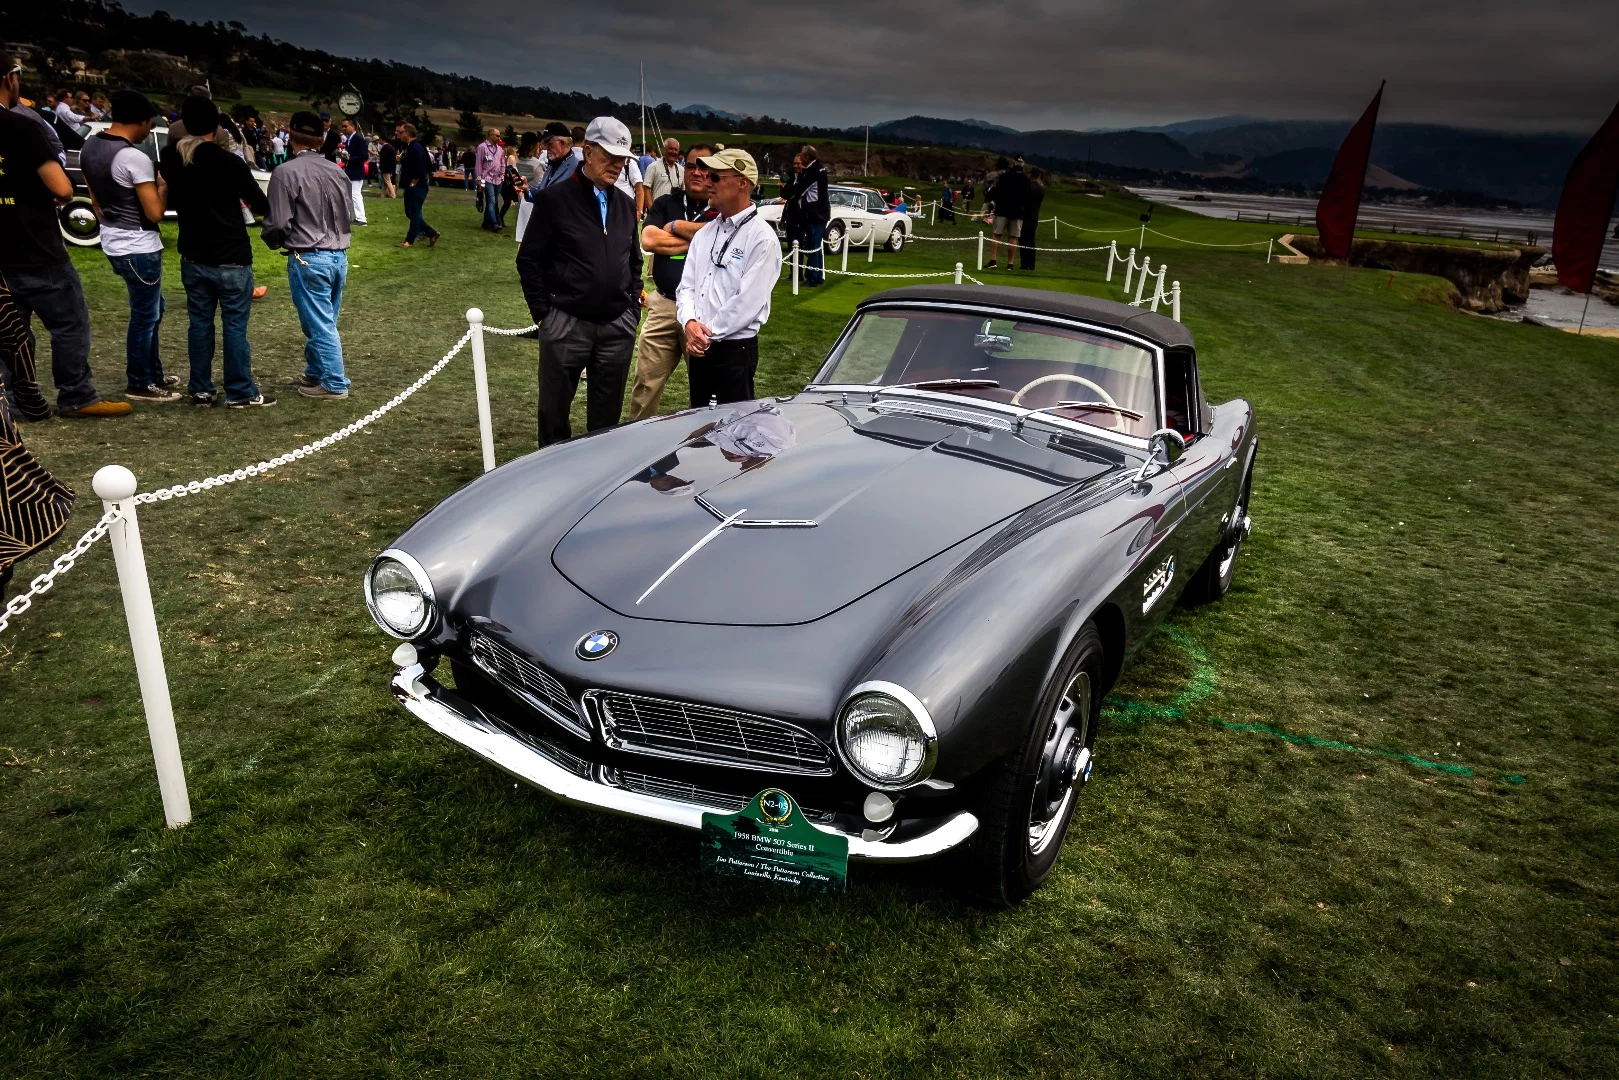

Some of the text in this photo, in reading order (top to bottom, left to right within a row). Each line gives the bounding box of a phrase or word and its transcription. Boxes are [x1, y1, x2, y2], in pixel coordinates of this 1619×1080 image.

[734, 831, 815, 852] 1958 BMW 507 Series II
[755, 843, 794, 857] Convertible
[716, 855, 727, 863] Jim
[728, 857, 755, 868] Patterson
[760, 863, 772, 871] The
[772, 865, 800, 876] Patterson
[801, 870, 830, 882] Collection
[743, 868, 801, 886] Louisville, Kentucky
